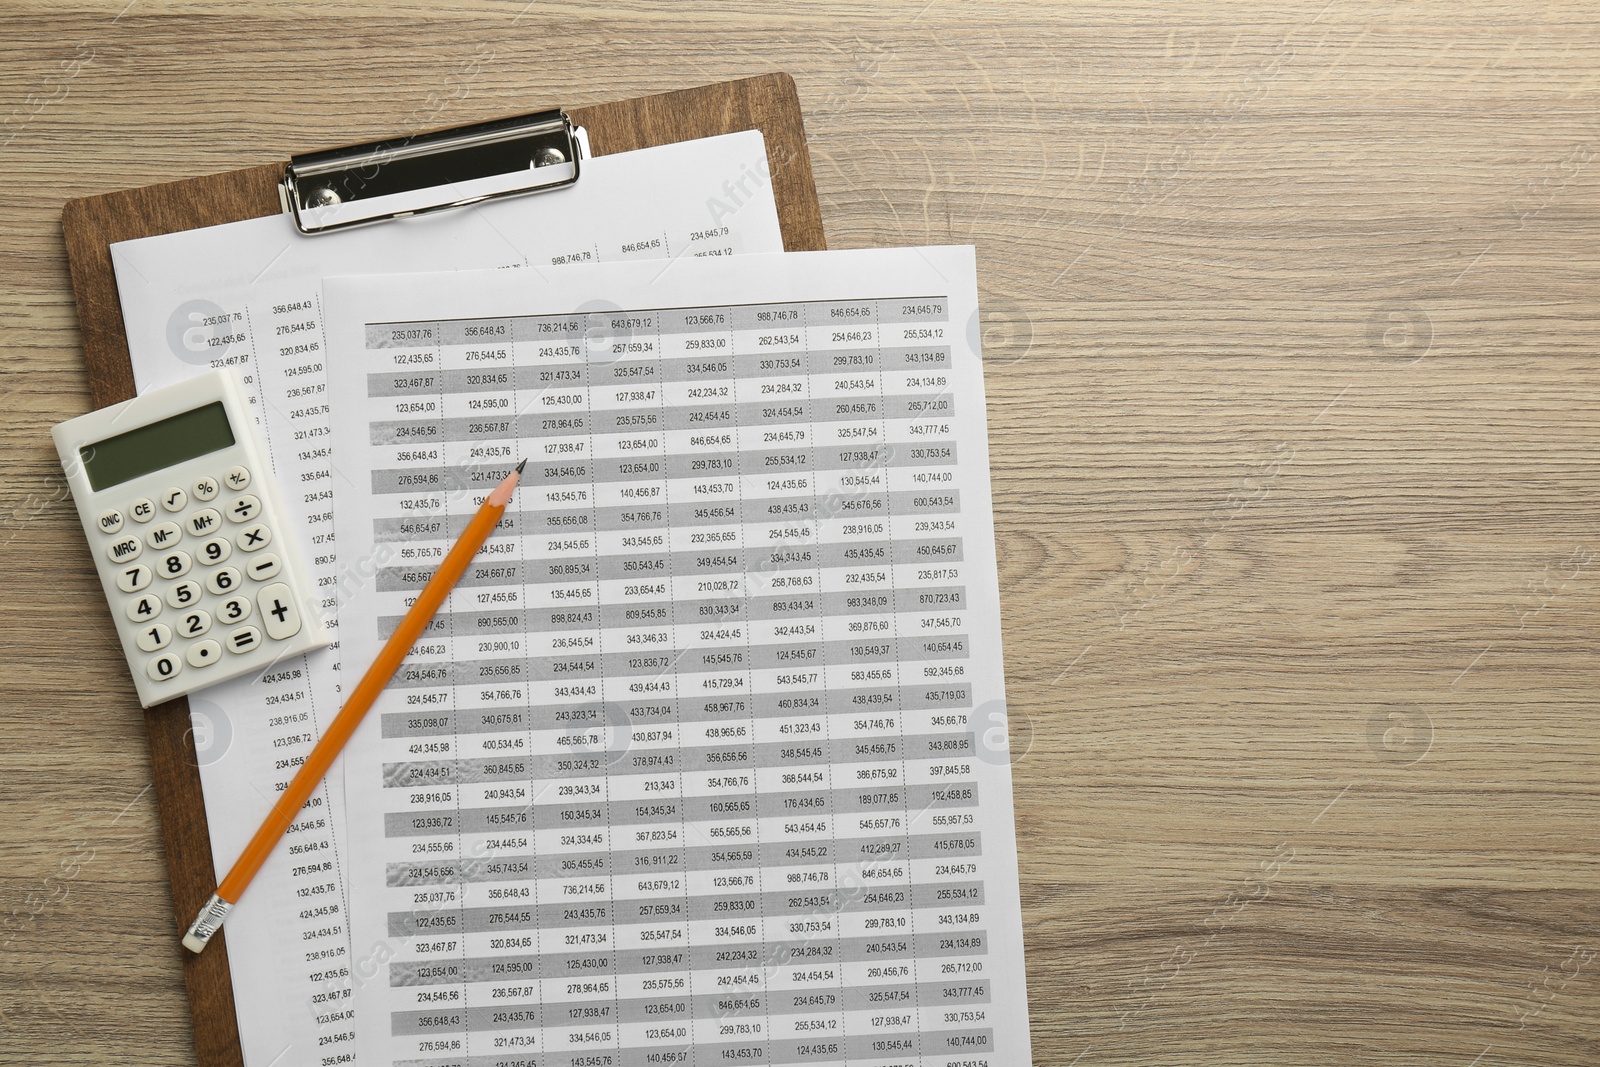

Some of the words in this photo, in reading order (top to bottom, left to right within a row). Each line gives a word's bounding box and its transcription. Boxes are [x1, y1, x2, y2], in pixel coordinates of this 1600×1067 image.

[552, 252, 591, 265] 988,746,78
[622, 239, 660, 253] 846,654,65
[691, 227, 728, 241] 234,645,79
[203, 313, 242, 326] 235,037,76
[273, 301, 312, 314] 356,648,43
[392, 329, 432, 340] 235,037,76
[465, 326, 505, 337] 356,648,43
[538, 322, 578, 333] 736,214,56
[612, 318, 651, 329] 643,679,12
[685, 314, 724, 325] 123,566,76
[757, 311, 798, 321] 988,746,78
[831, 307, 870, 318] 846,654,65
[903, 305, 942, 315] 234,645,79
[207, 333, 246, 346] 122,435,65
[276, 321, 315, 335] 276,544,55
[210, 355, 248, 368] 323,467,87
[280, 342, 319, 356] 320,834,65
[284, 363, 322, 376] 124,595,00
[287, 384, 325, 398] 236,567,87
[396, 402, 435, 413] 123,654,00
[469, 399, 508, 409] 124,595,00
[542, 395, 582, 405] 125,430,00
[616, 391, 655, 401] 127,938,47
[688, 387, 728, 398] 242,234,32
[761, 383, 802, 394] 234,284,32
[835, 380, 874, 390] 240,543,54
[907, 377, 946, 387] 234,134,89
[290, 405, 329, 419] 243,435,76
[397, 450, 437, 461] 356,648,43
[470, 447, 511, 458] 243,435,76
[544, 443, 584, 454] 127,938,47
[618, 439, 658, 450] 123,654,00
[691, 435, 731, 446] 846,654,65
[764, 431, 804, 442] 234,645,79
[838, 427, 877, 438] 325,547,54
[910, 425, 949, 435] 343,777,45
[134, 502, 150, 515] CE
[112, 539, 136, 557] MRC
[193, 514, 213, 530] M+
[402, 548, 441, 558] 565,765,76
[548, 540, 589, 551] 234,545,65
[622, 536, 663, 547] 343,545,65
[691, 532, 736, 543] 232,365,655
[769, 528, 810, 539] 254,545,45
[843, 524, 883, 535] 238,916,05
[915, 521, 954, 531] 239,343,54
[125, 567, 139, 586] 7
[166, 555, 181, 572] 8
[205, 541, 220, 559] 9
[136, 598, 151, 615] 4
[176, 584, 191, 602] 5
[215, 570, 231, 588] 6
[477, 592, 517, 603] 127,455,65
[551, 588, 591, 599] 135,445,65
[625, 584, 665, 596] 233,654,45
[698, 580, 738, 591] 210,028,72
[772, 576, 812, 587] 258,768,63
[846, 573, 885, 583] 232,435,54
[918, 569, 958, 580] 235,817,53
[148, 627, 160, 644] 1
[186, 614, 202, 632] 2
[225, 600, 241, 618] 3
[479, 641, 519, 652] 230,900,10
[553, 637, 593, 648] 236,545,54
[627, 633, 667, 644] 343,346,33
[701, 629, 741, 640] 324,424,45
[775, 625, 815, 636] 342,443,54
[849, 621, 888, 632] 369,876,60
[921, 617, 961, 628] 347,545,70
[156, 657, 172, 675] 0
[263, 670, 301, 683] 424,345,98
[266, 691, 304, 705] 324,434,51
[407, 693, 447, 705] 324,545,77
[481, 690, 521, 701] 354,766,76
[555, 686, 596, 697] 343,434,43
[629, 682, 670, 693] 439,434,43
[703, 678, 743, 689] 415,729,34
[777, 674, 817, 685] 543,545,77
[851, 670, 891, 681] 583,455,65
[924, 666, 964, 677] 592,345,68
[269, 712, 308, 726] 238,916,05
[273, 733, 311, 747] 123,936,72
[409, 743, 449, 753] 424,345,98
[483, 739, 523, 750] 400,534,45
[557, 735, 598, 746] 465,565,78
[632, 731, 672, 742] 430,837,94
[705, 727, 746, 738] 438,965,65
[780, 723, 820, 734] 451,323,43
[854, 719, 894, 730] 354,746,76
[931, 715, 967, 726] 345,66,78
[411, 792, 451, 804] 238,916,05
[484, 789, 525, 800] 240,943,54
[559, 785, 600, 796] 239,343,34
[645, 780, 675, 791] 213,343
[708, 777, 748, 788] 354,766,76
[782, 773, 823, 784] 368,544,54
[857, 768, 897, 780] 386,675,92
[930, 765, 970, 776] 397,845,58
[413, 842, 453, 853] 234,555,66
[487, 838, 527, 849] 234,445,54
[561, 834, 602, 845] 324,334,45
[636, 830, 677, 841] 367,823,54
[711, 826, 751, 837] 565,565,56
[785, 822, 826, 833] 543,454,45
[860, 818, 900, 830] 545,657,76
[933, 814, 973, 826] 555,957,53
[289, 841, 329, 855] 356,648,43
[292, 862, 332, 876] 276,594,86
[297, 883, 335, 897] 132,435,76
[300, 905, 339, 918] 424,345,98
[303, 926, 341, 940] 324,434,51
[416, 941, 456, 953] 323,467,87
[490, 937, 531, 949] 320,834,65
[565, 934, 606, 945] 321,473,34
[641, 930, 681, 941] 325,547,54
[715, 925, 756, 937] 334,546,05
[790, 922, 831, 933] 330,753,54
[865, 917, 905, 929] 299,783,10
[939, 913, 979, 925] 343,134,89
[306, 947, 345, 961] 238,916,05
[309, 968, 348, 982] 122,435,65
[312, 989, 351, 1003] 323,467,87
[419, 1040, 460, 1051] 276,594,86
[494, 1036, 535, 1047] 321,473,34
[569, 1032, 611, 1043] 334,546,05
[646, 1028, 686, 1039] 123,654,00
[720, 1024, 761, 1035] 299,783,10
[795, 1020, 836, 1031] 255,534,12
[871, 1015, 911, 1027] 127,938,47
[944, 1011, 985, 1022] 330,753,54
